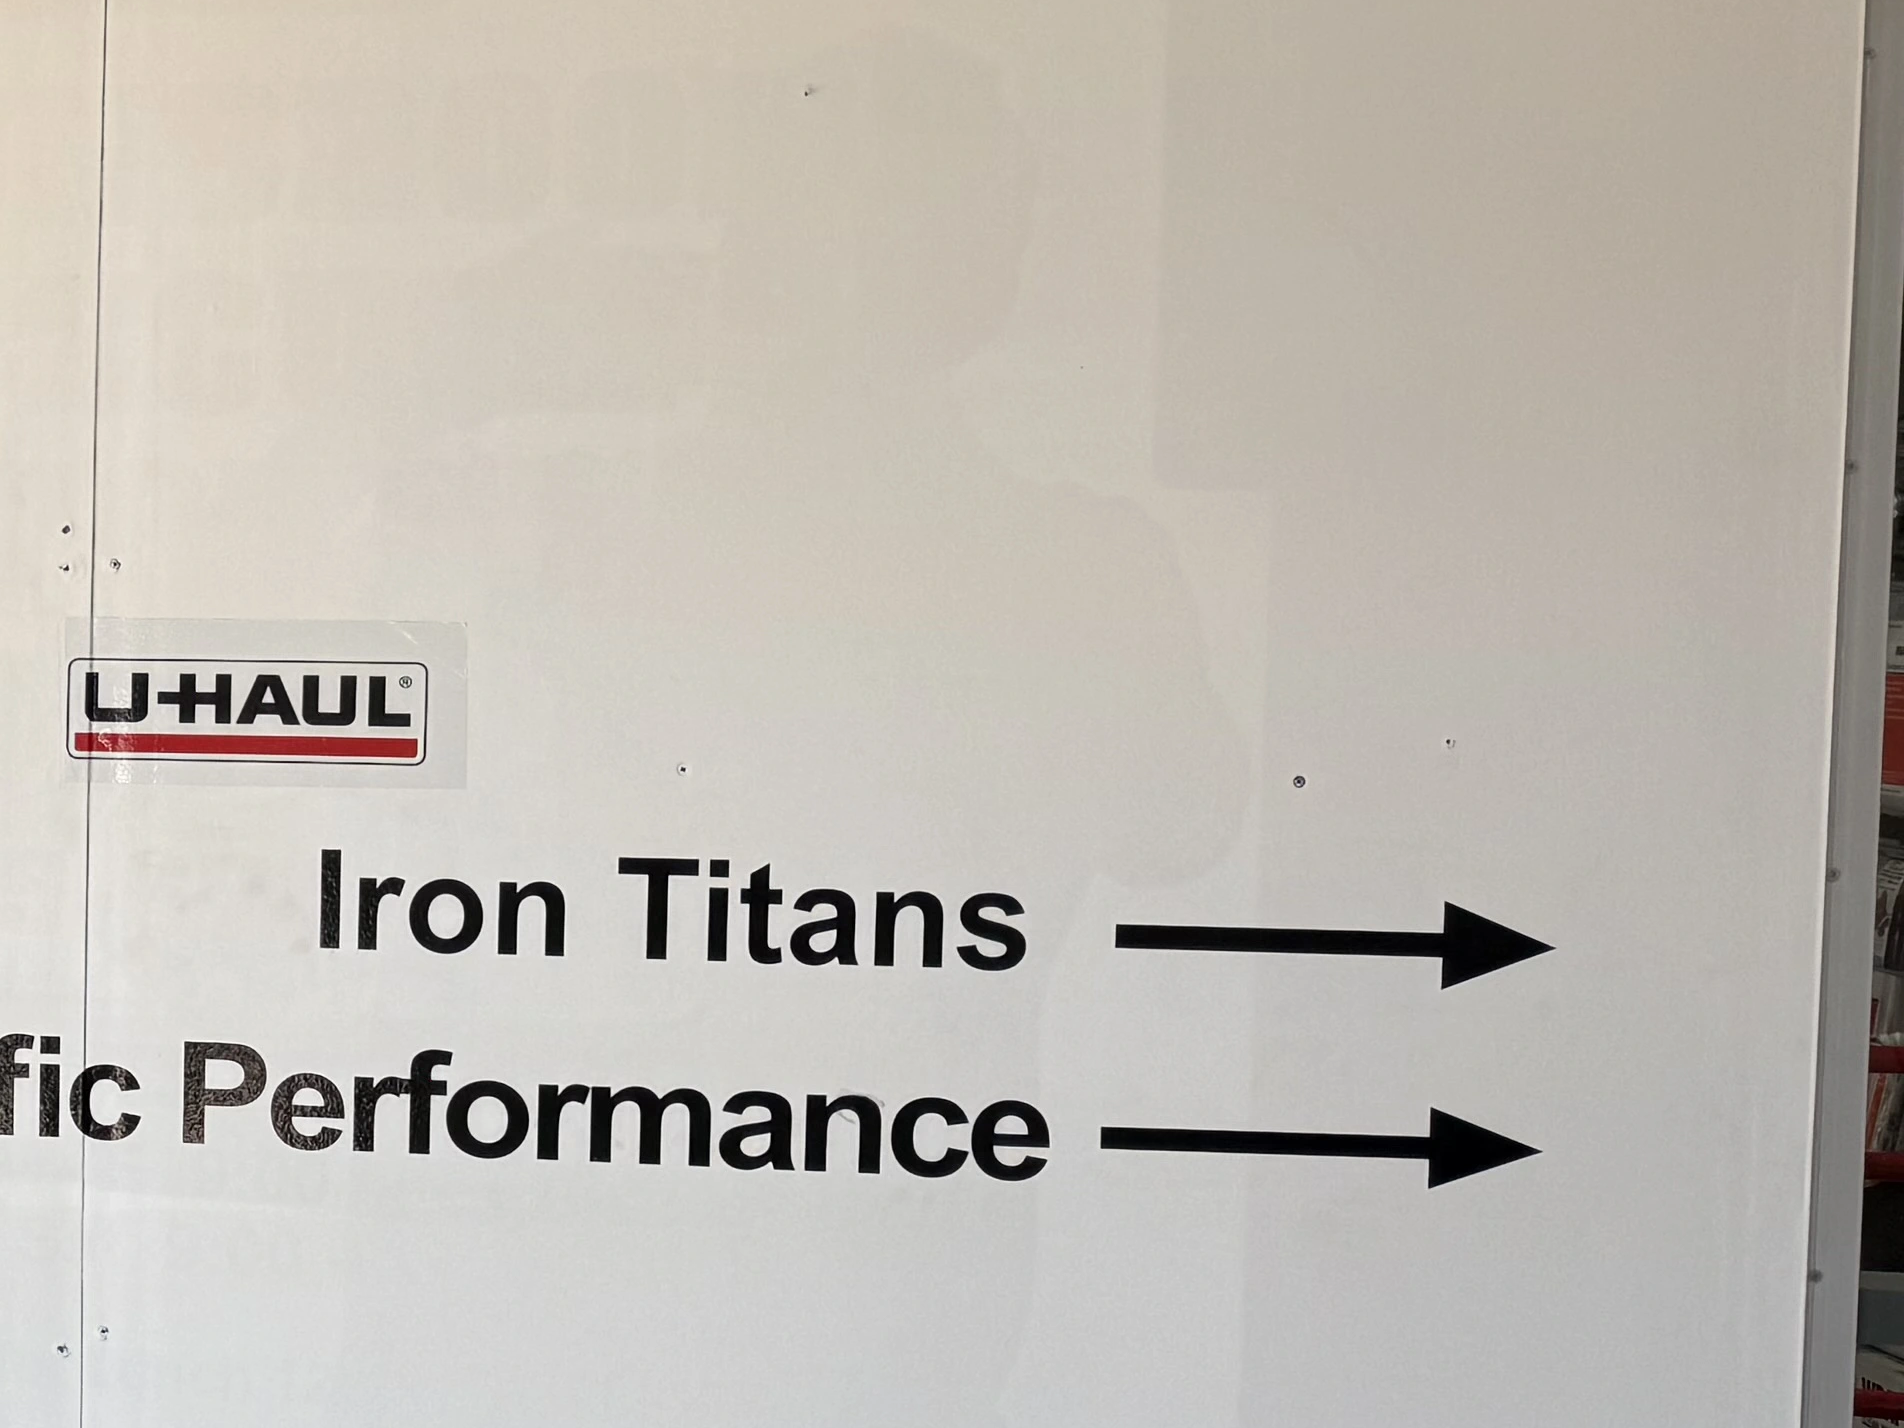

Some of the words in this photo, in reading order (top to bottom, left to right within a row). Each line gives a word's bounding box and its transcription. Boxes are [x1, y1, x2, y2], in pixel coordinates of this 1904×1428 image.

[83, 669, 413, 728] U-HAUL
[319, 849, 567, 958] Iron
[618, 857, 1028, 972] Titans
[182, 1040, 1051, 1182] Performance
